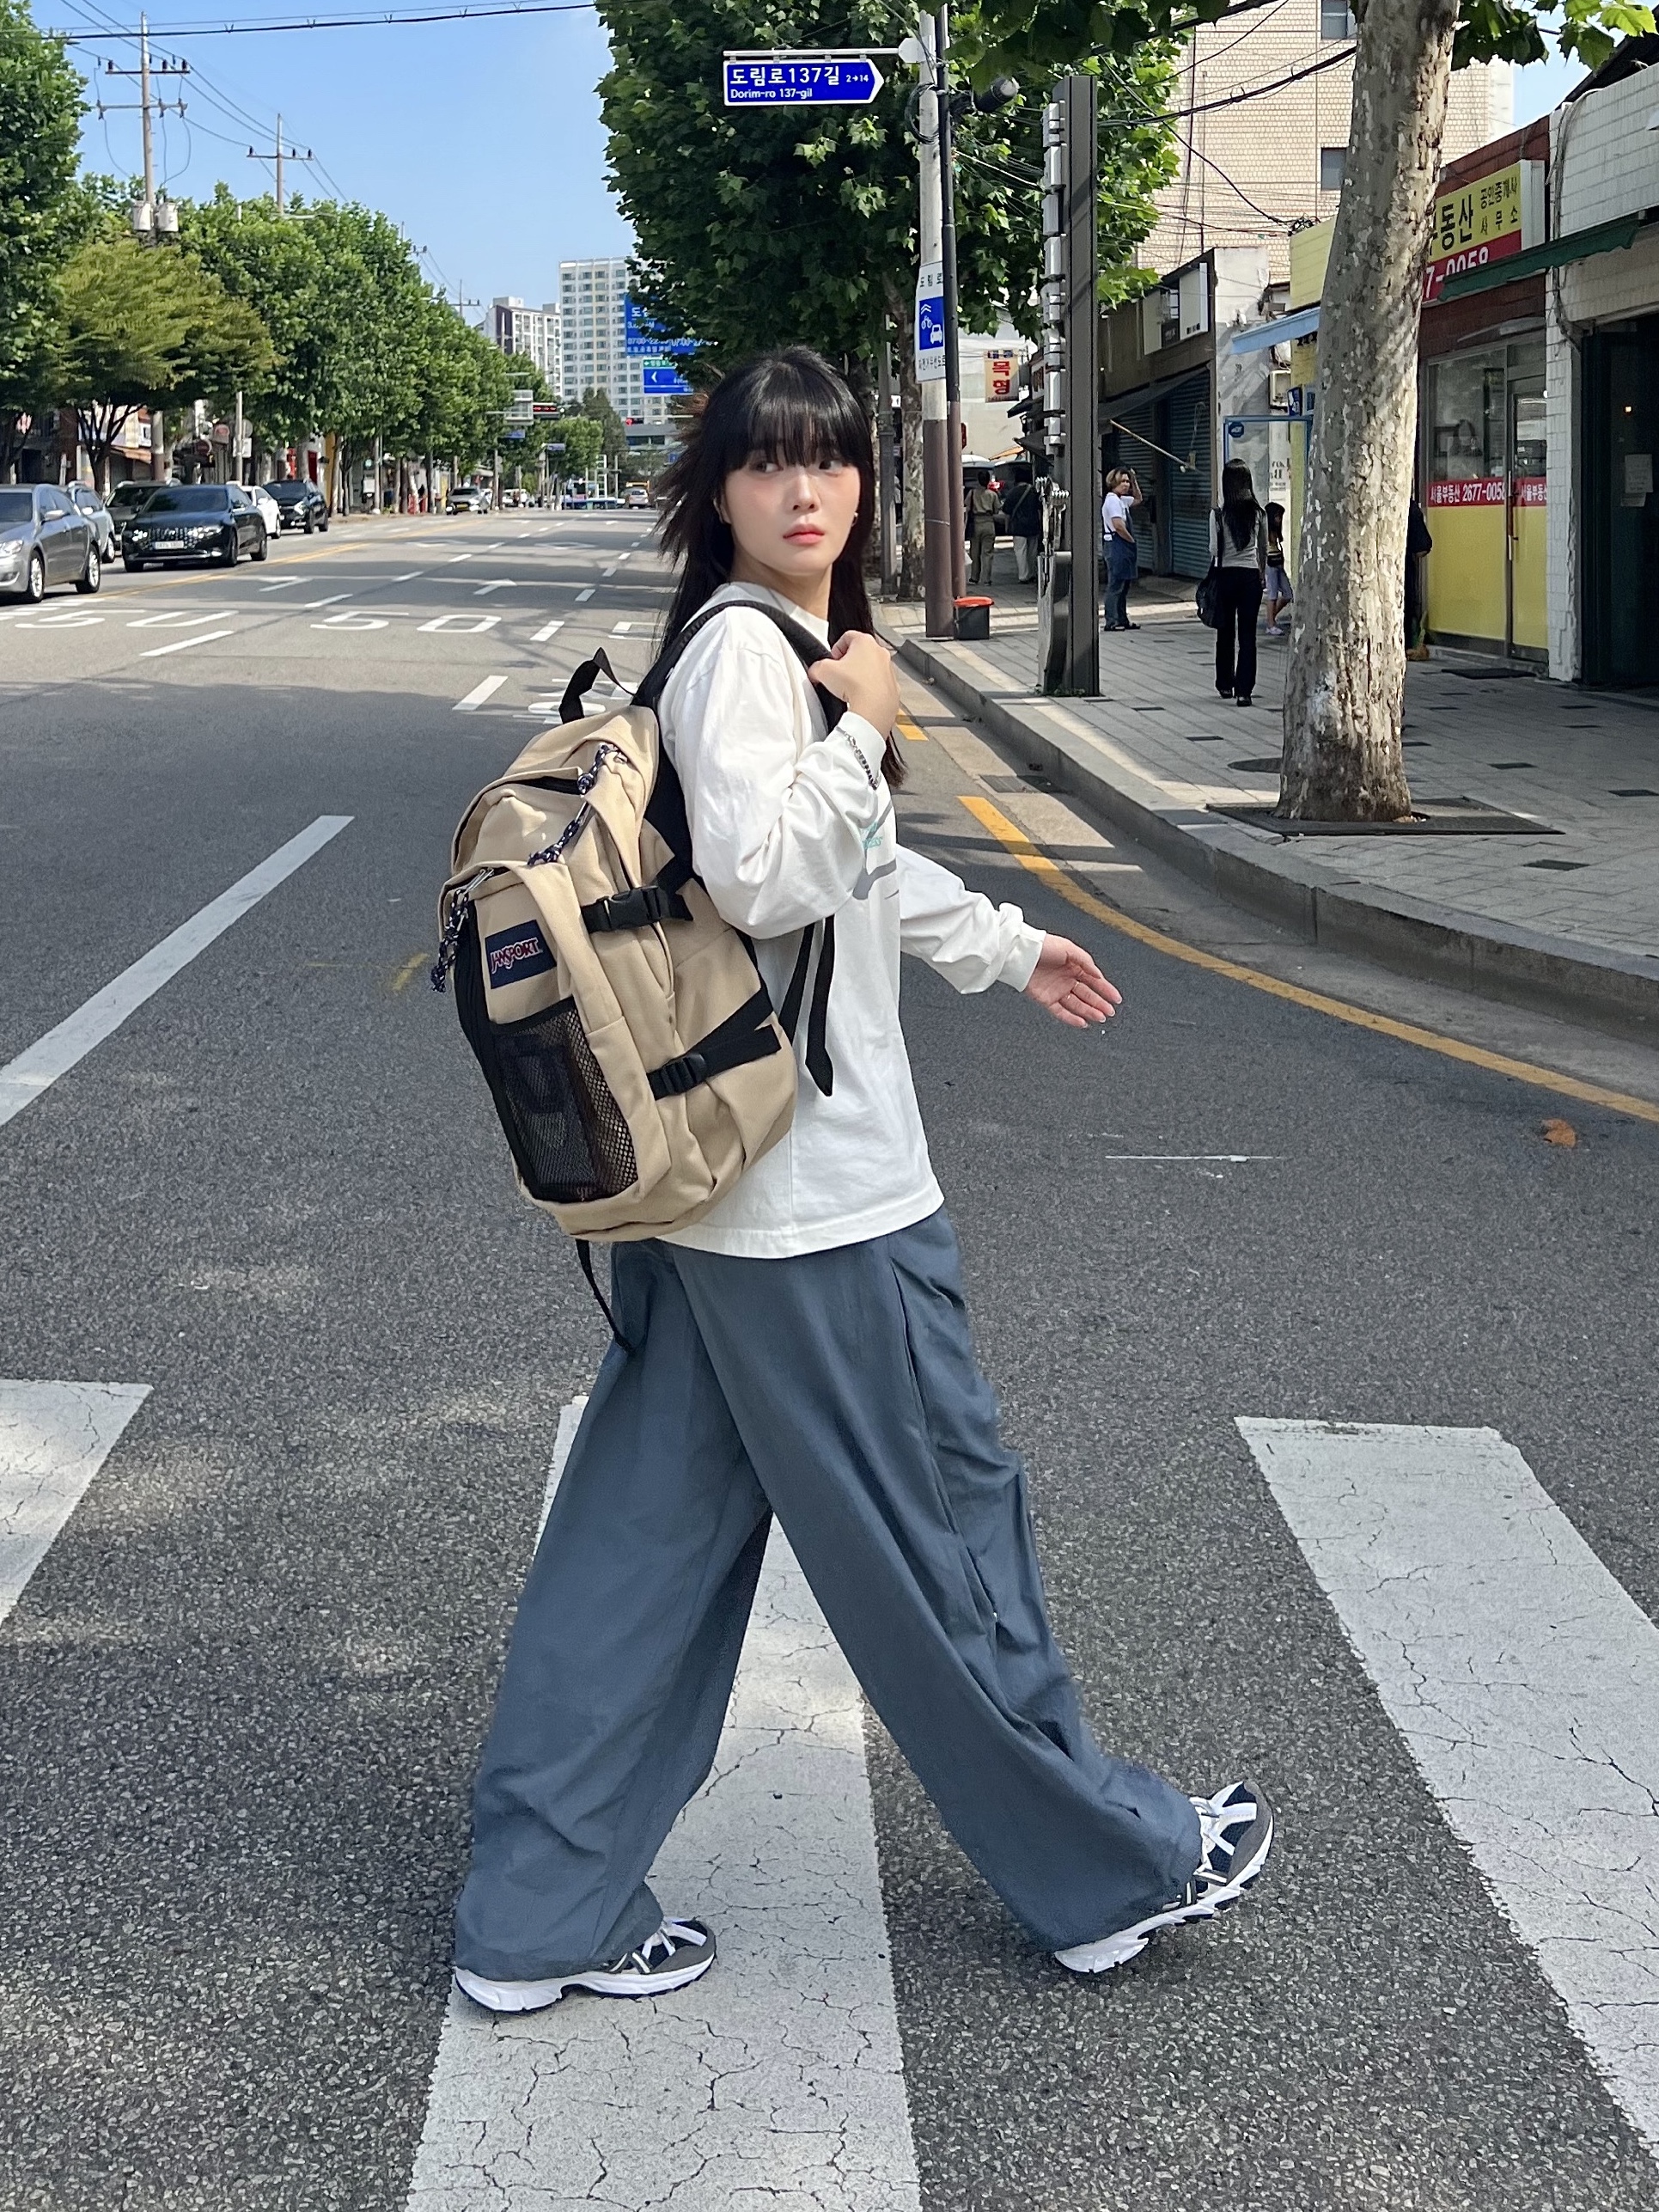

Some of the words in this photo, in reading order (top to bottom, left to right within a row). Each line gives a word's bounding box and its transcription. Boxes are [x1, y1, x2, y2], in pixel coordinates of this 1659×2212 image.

[730, 65, 839, 87] 도림로137길
[730, 89, 776, 99] Dorim-ro
[780, 88, 813, 100] 137-gil
[1480, 176, 1518, 209] 공인중개사
[1429, 194, 1473, 256] 동산
[992, 361, 1011, 395] 목형
[1430, 484, 1461, 504] 서울부동산
[310, 611, 502, 633] 50
